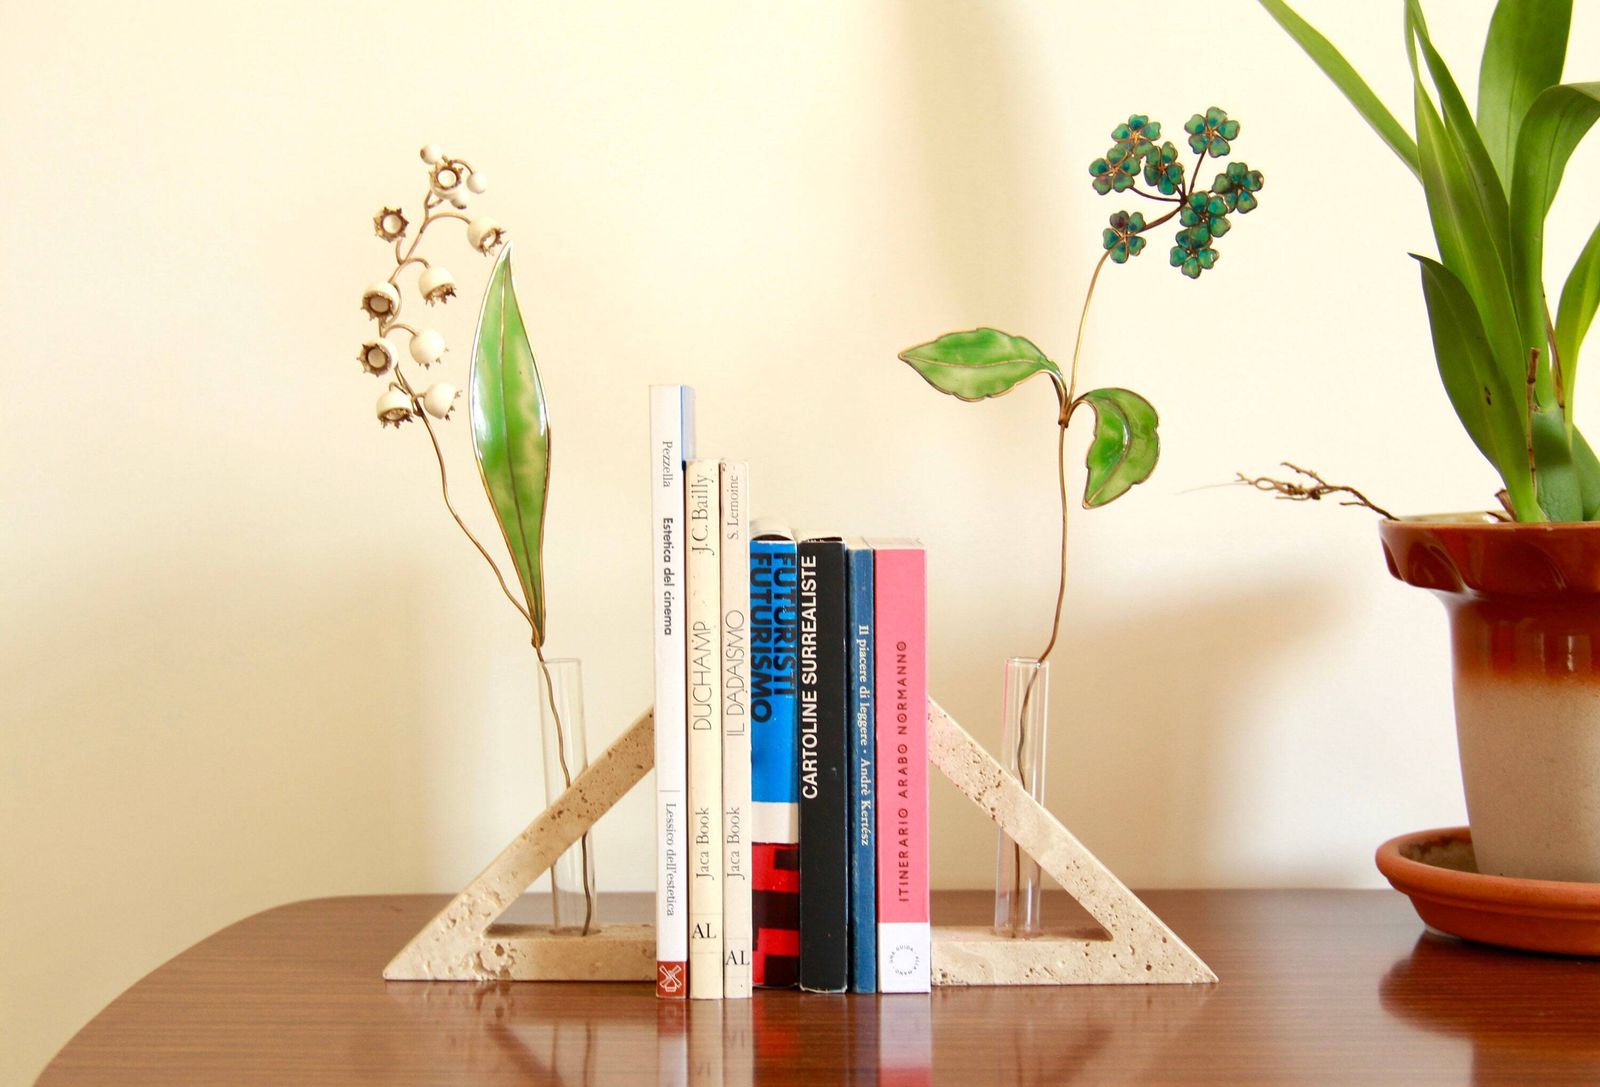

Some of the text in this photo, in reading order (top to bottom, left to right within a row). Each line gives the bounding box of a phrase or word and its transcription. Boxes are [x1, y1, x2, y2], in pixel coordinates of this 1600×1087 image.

[662, 441, 673, 488] Pezzella
[691, 474, 714, 520] Bailly
[727, 475, 739, 540] S. Lemoine
[663, 517, 675, 636] Estetica del cinema
[750, 552, 773, 724] FUTURISMO
[773, 551, 796, 697] FUTURISTI
[858, 624, 869, 635] Il
[692, 620, 712, 731] DUCHAMP
[725, 609, 745, 737] IL DADAISMO
[801, 555, 818, 800] CARTOLINE SURREALISTE
[856, 638, 870, 682] piacere
[859, 685, 871, 699] di
[857, 701, 870, 746] leggere
[897, 640, 910, 903] ITINERARIO ARABO NORMANNO
[695, 807, 715, 881] Jaca Book
[726, 807, 746, 881] Jaca Book
[861, 799, 873, 847] Kertész
[665, 802, 677, 917] Lessico dell'estetica
[692, 922, 717, 940] AL
[725, 949, 750, 966] AL
